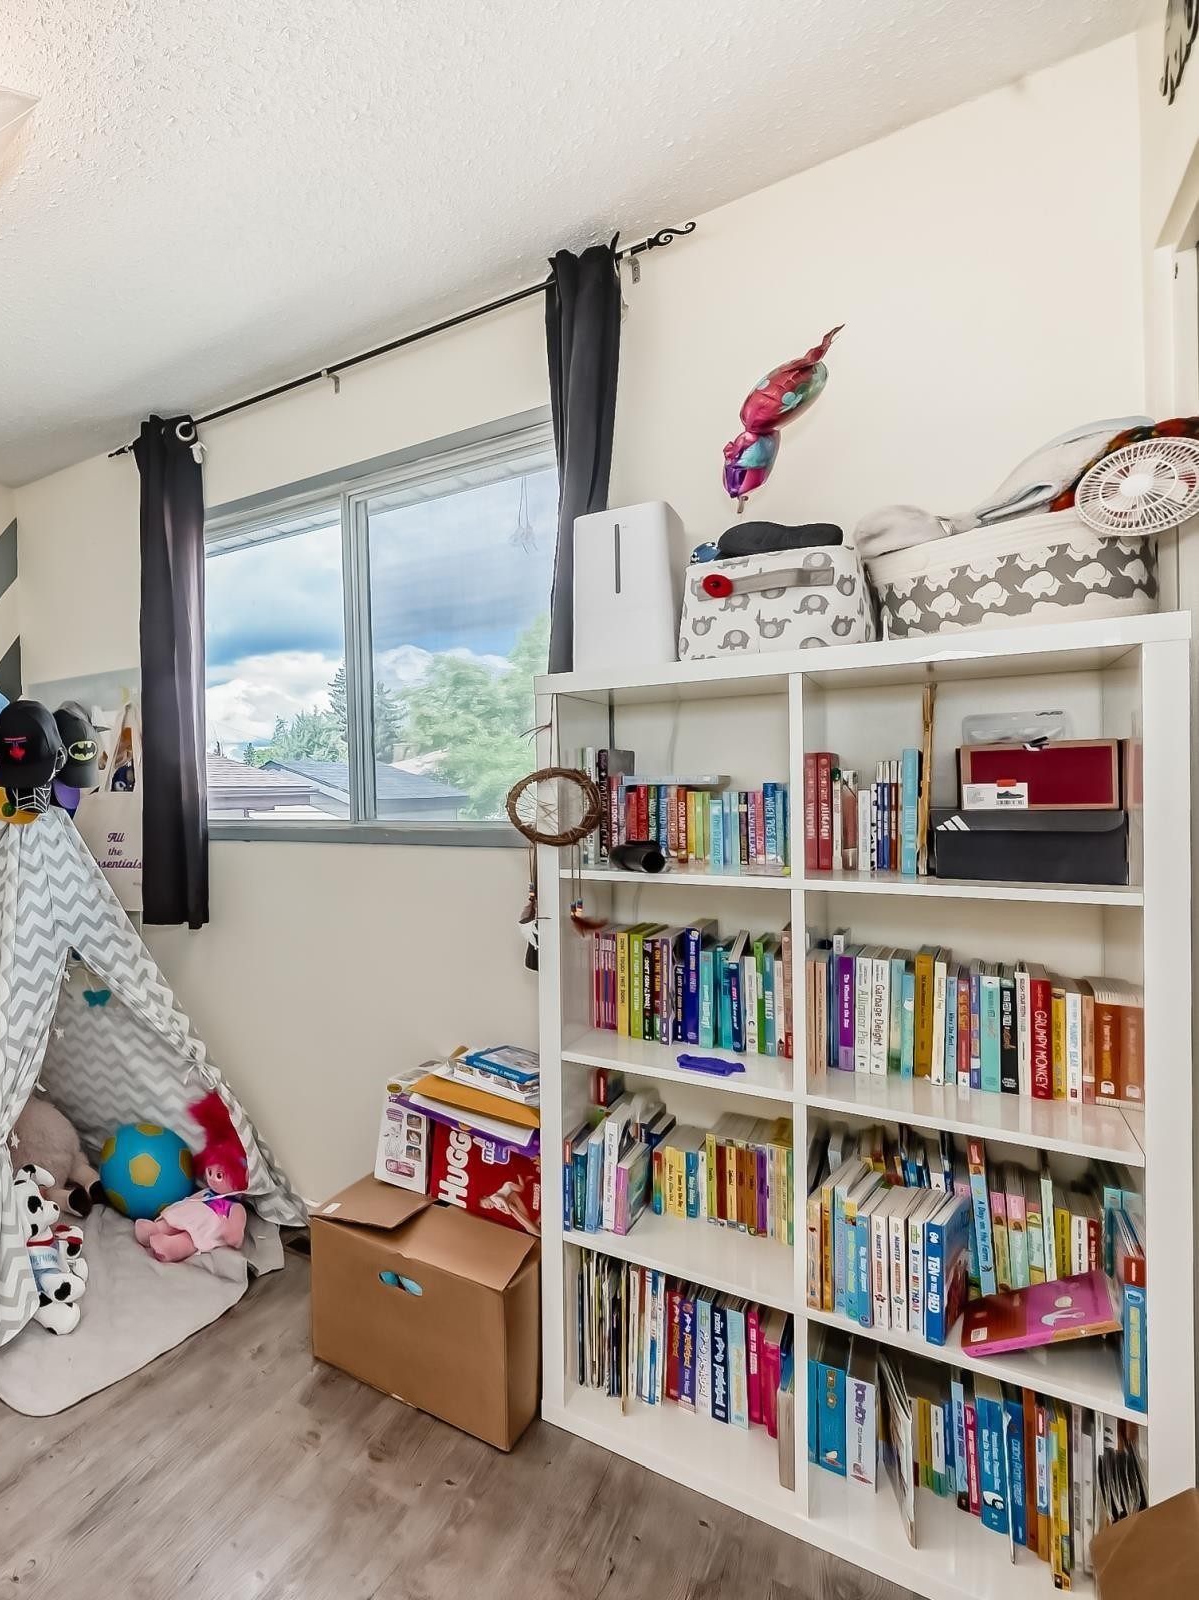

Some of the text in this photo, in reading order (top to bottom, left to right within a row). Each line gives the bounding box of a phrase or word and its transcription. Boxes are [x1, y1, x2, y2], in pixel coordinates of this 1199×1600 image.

[638, 823, 646, 840] NOS
[765, 818, 776, 836] PIGS
[106, 832, 125, 843] All
[108, 847, 123, 856] the
[95, 858, 143, 869] ssentials
[857, 989, 868, 1046] Alligator Pie
[873, 984, 885, 1046] Garbage Delight
[1034, 1010, 1048, 1089] GRUMPY MONKEY
[976, 1206, 985, 1218] Day
[980, 1222, 984, 1230] on
[928, 1256, 940, 1276] TEN
[912, 1276, 920, 1314] BIRTHDAY
[928, 1292, 940, 1314] BED
